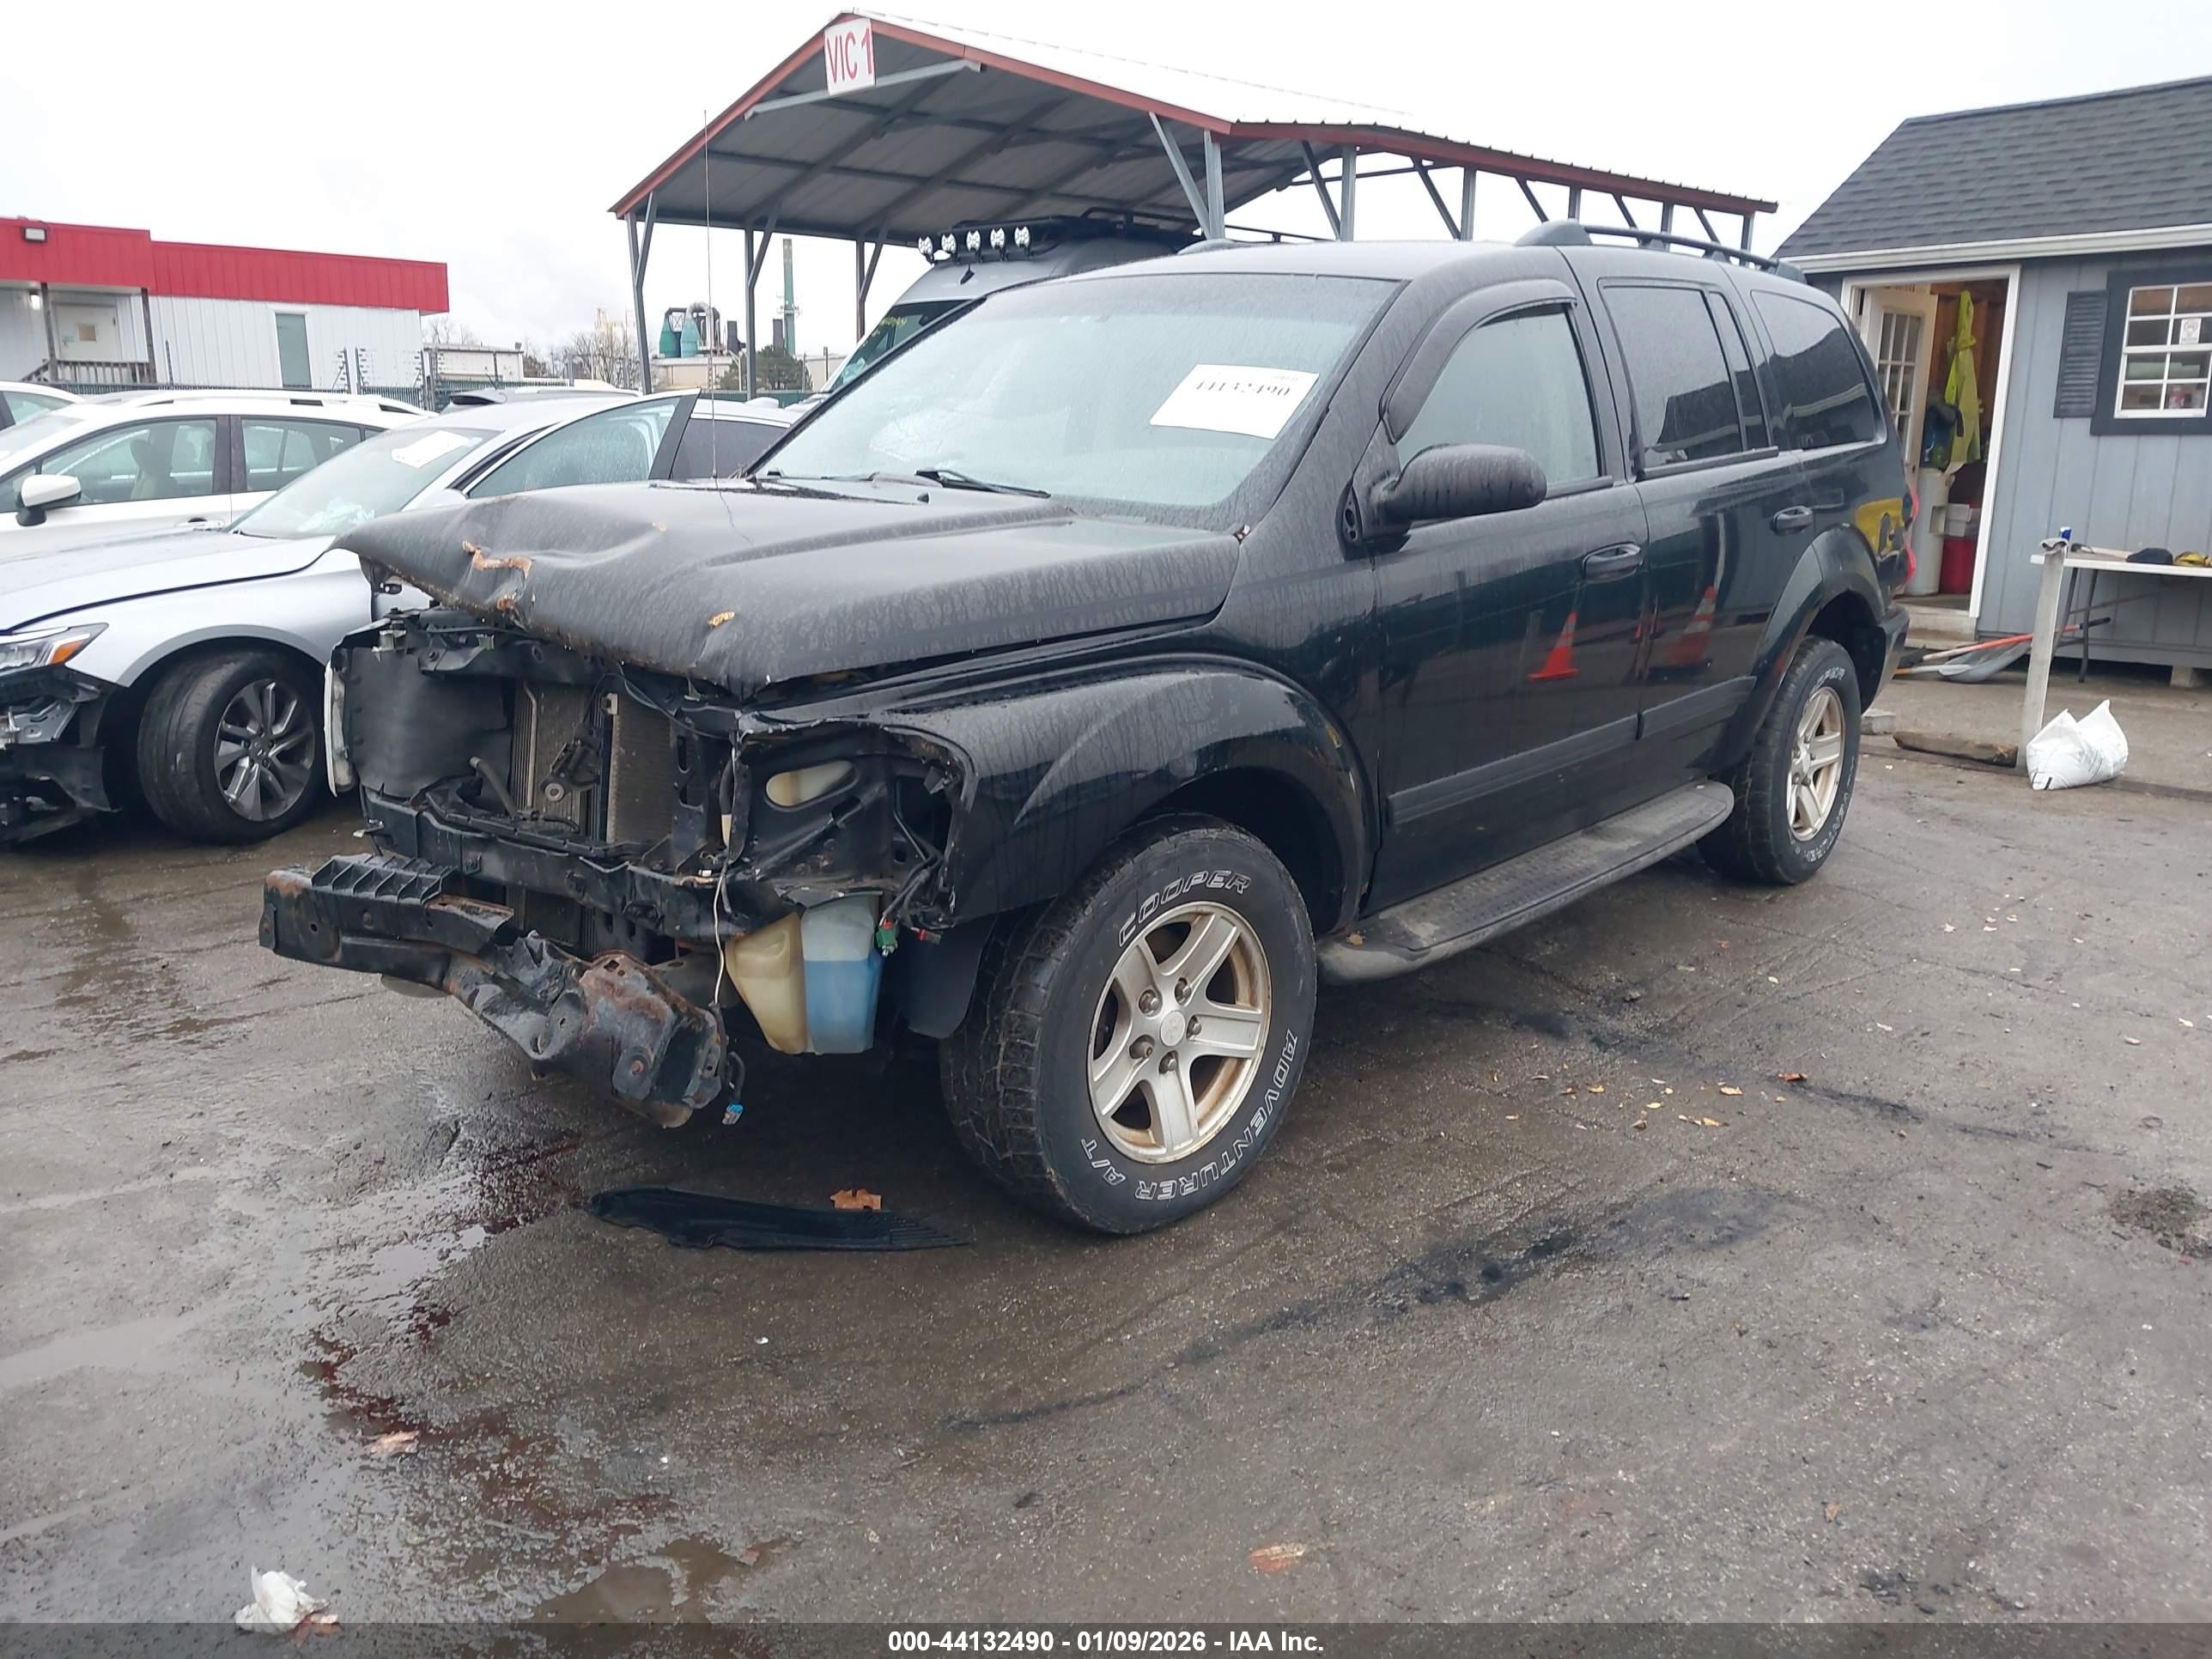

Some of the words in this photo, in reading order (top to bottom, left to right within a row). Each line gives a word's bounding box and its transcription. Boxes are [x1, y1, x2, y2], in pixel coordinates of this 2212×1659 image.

[827, 31, 858, 83] VIC
[861, 27, 872, 76] 1
[1118, 869, 1252, 947] COOPER
[1134, 1028, 1298, 1200] ADVENTURER
[1080, 1138, 1127, 1186] A/T
